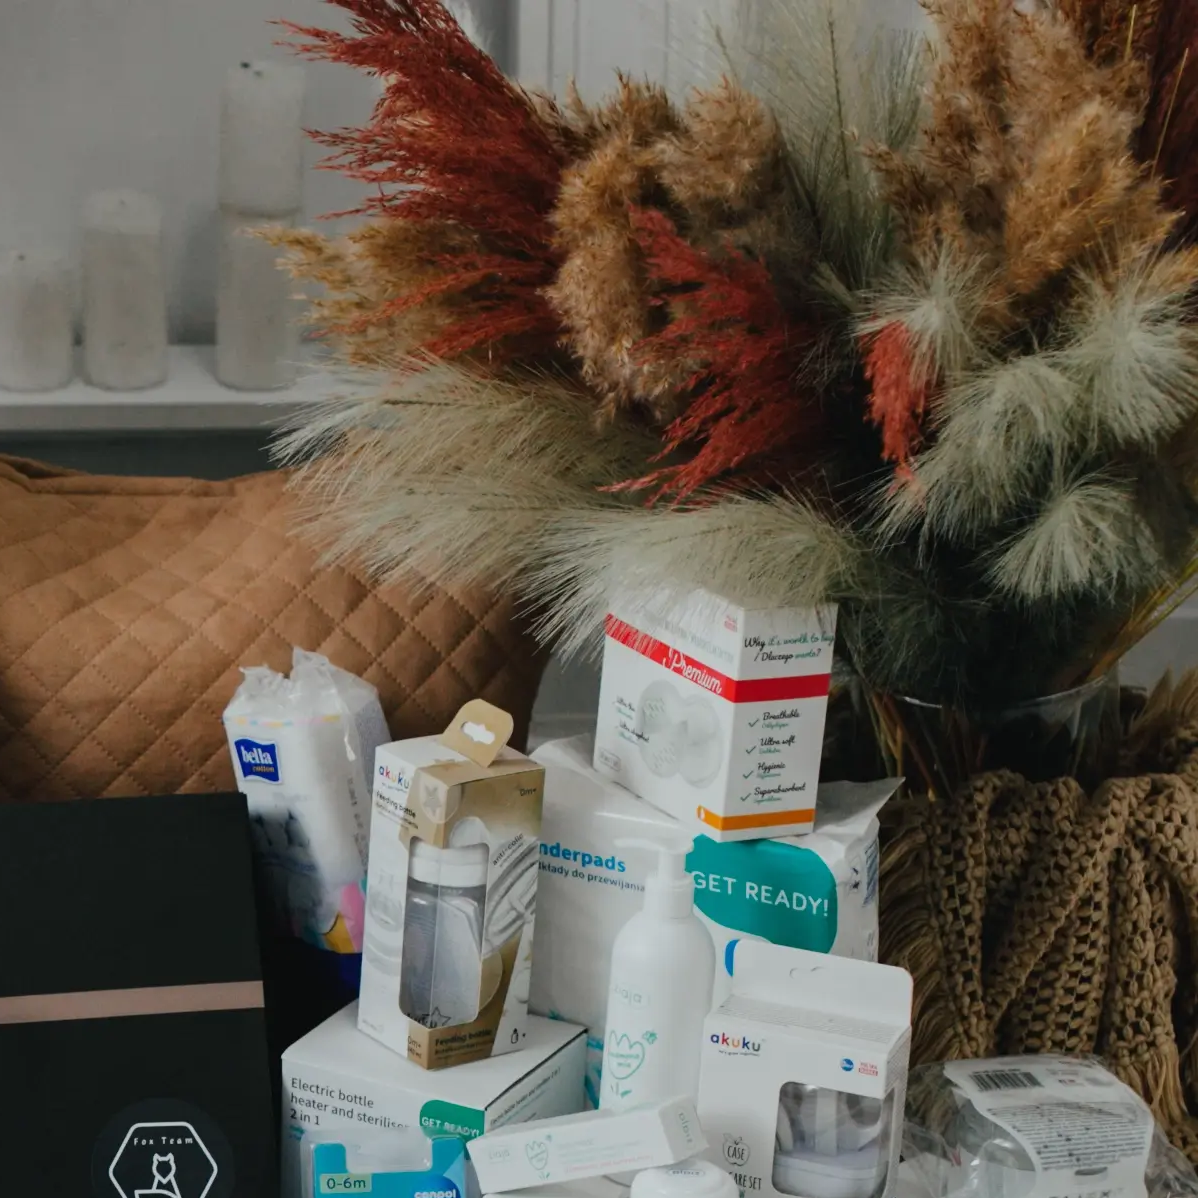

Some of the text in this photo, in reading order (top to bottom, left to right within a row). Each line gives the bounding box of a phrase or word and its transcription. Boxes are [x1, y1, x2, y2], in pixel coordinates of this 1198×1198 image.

[744, 635, 766, 651] Why
[763, 709, 801, 721] Breathable
[240, 745, 274, 765] bella
[379, 765, 410, 790] akuku
[539, 841, 627, 873] nderpads
[572, 868, 585, 879] do
[691, 870, 830, 917] GET READY!
[710, 1032, 761, 1052] akuku
[291, 1076, 375, 1109] Electric bottle
[290, 1092, 329, 1113] heater
[331, 1104, 354, 1119] and
[290, 1108, 320, 1126] 2 in 1
[421, 1116, 443, 1129] GET
[133, 1136, 193, 1146] Fox Team
[727, 1145, 745, 1160] CASE
[326, 1177, 367, 1190] 0-6m
[729, 1171, 762, 1190] ARE SET
